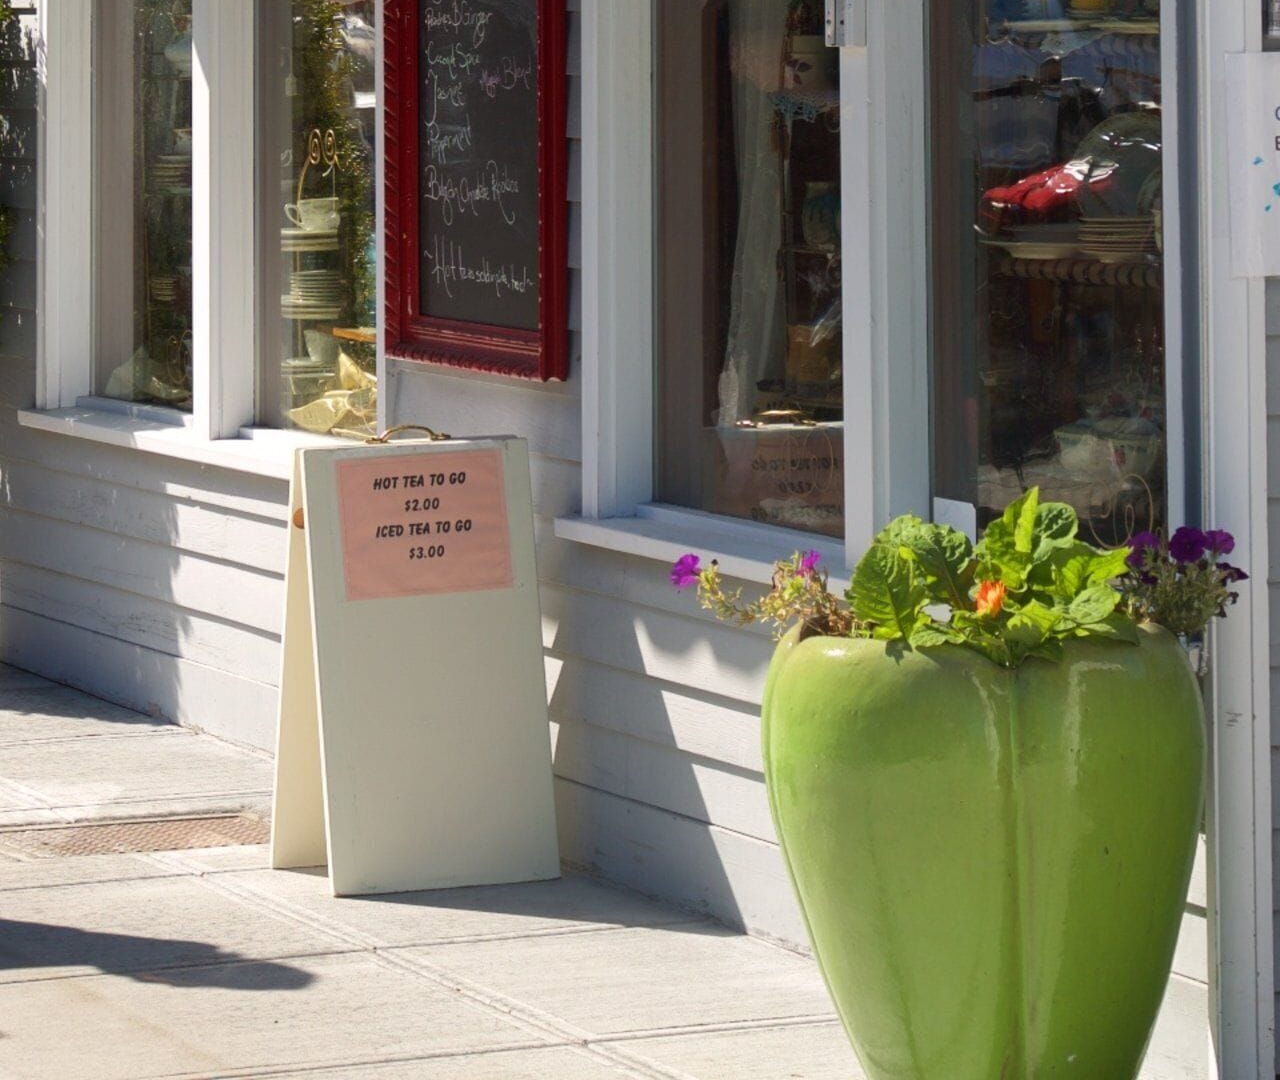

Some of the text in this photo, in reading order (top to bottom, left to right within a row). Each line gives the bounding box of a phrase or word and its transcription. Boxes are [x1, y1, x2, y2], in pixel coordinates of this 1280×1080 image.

[373, 471, 466, 491] HOT TEA TO GO
[404, 497, 440, 512] $2.00
[376, 519, 472, 539] ICED TEA TO GO
[409, 545, 445, 560] $3.00
